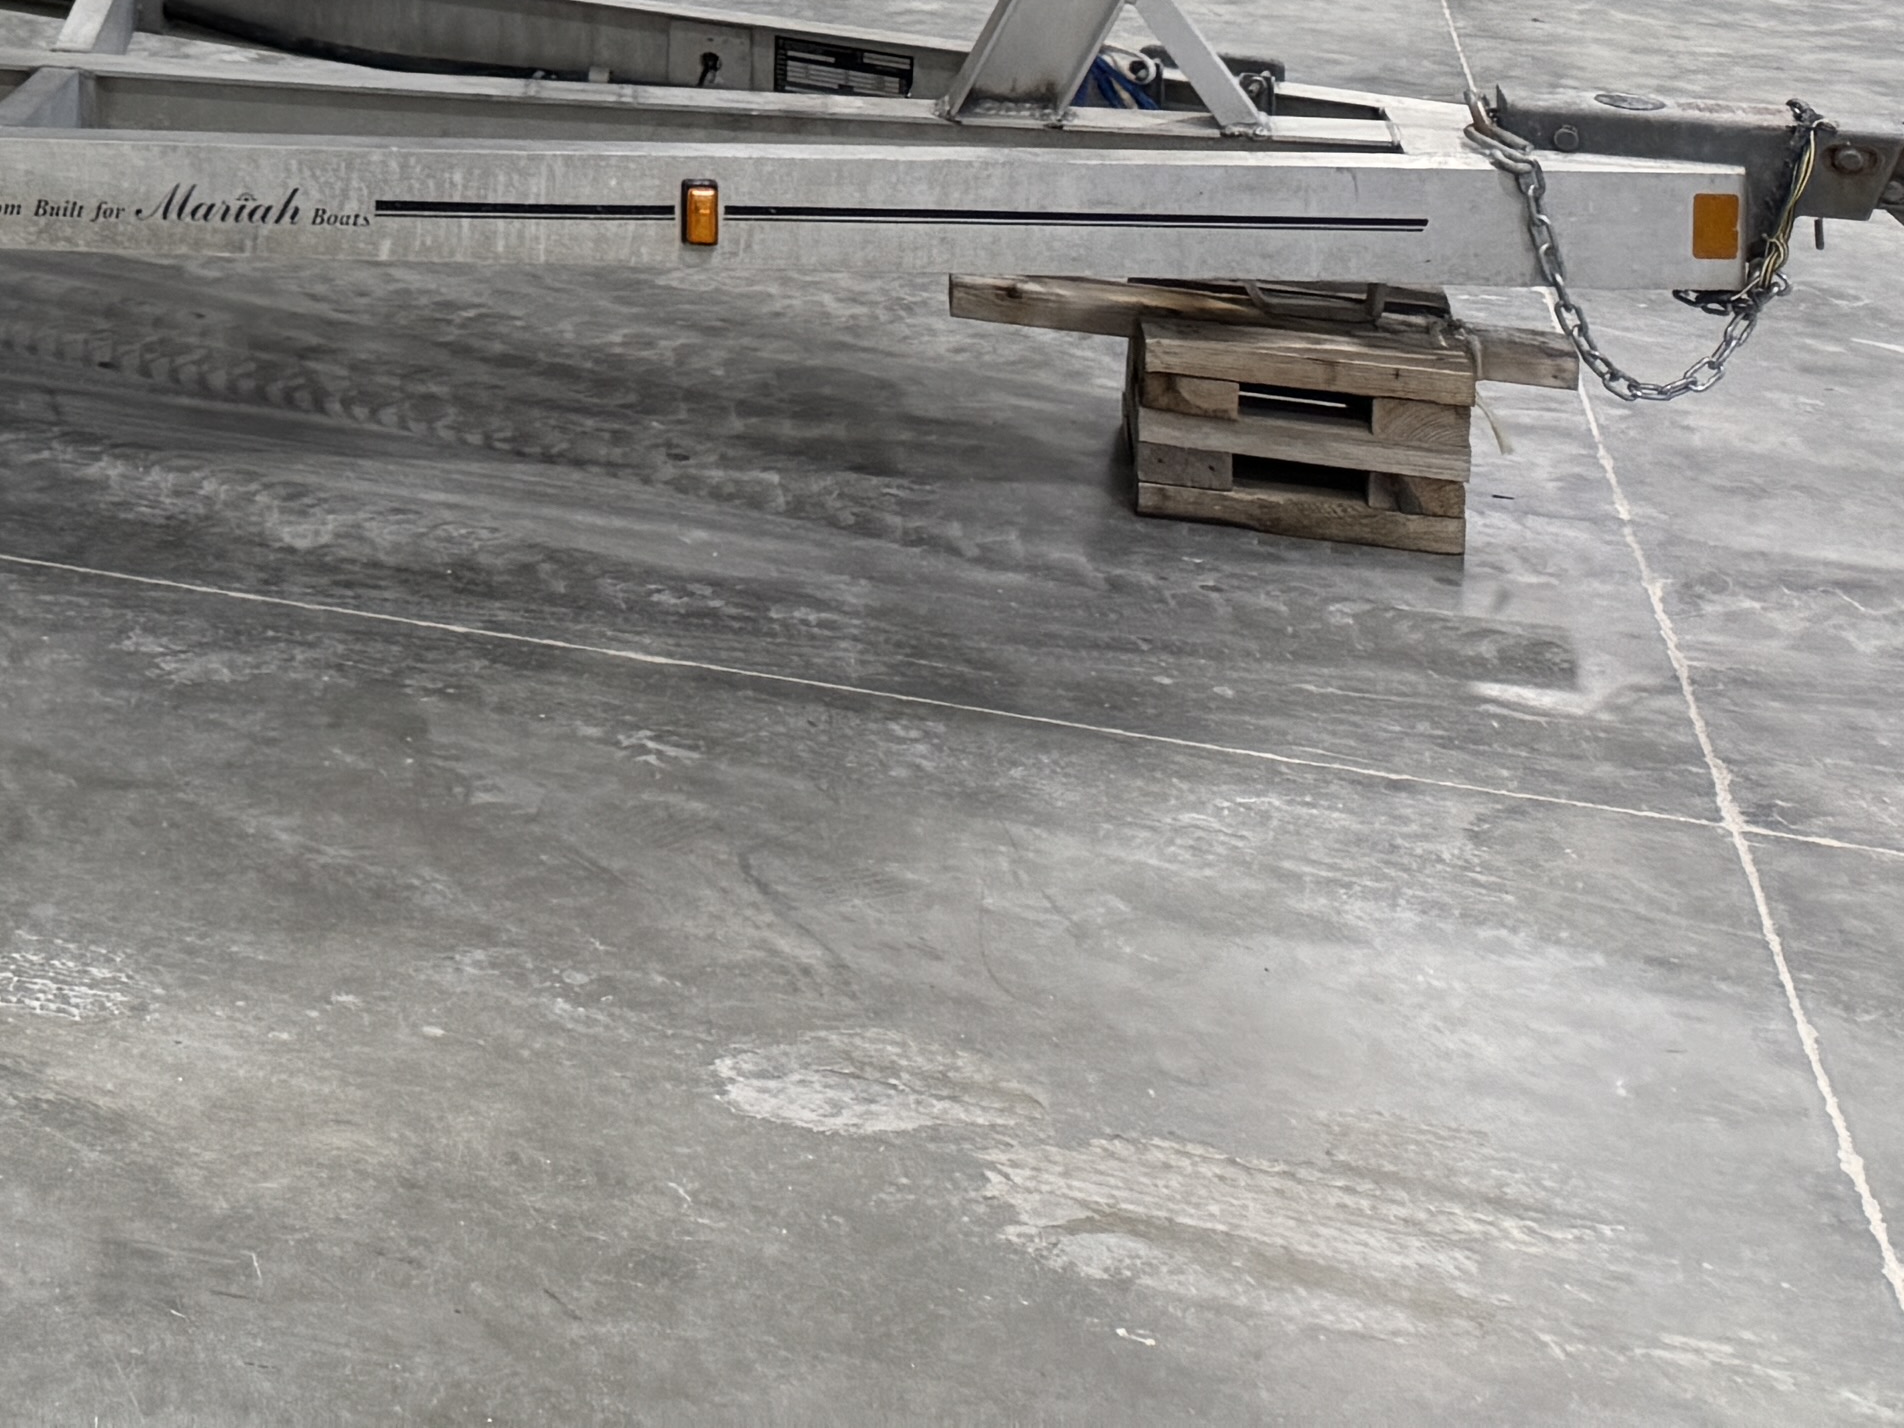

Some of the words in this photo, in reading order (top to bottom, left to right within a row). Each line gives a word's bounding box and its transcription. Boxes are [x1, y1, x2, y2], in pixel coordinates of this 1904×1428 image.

[33, 198, 85, 219] Built
[89, 200, 126, 223] for
[135, 182, 301, 225] Mariah
[310, 206, 372, 228] Boats
